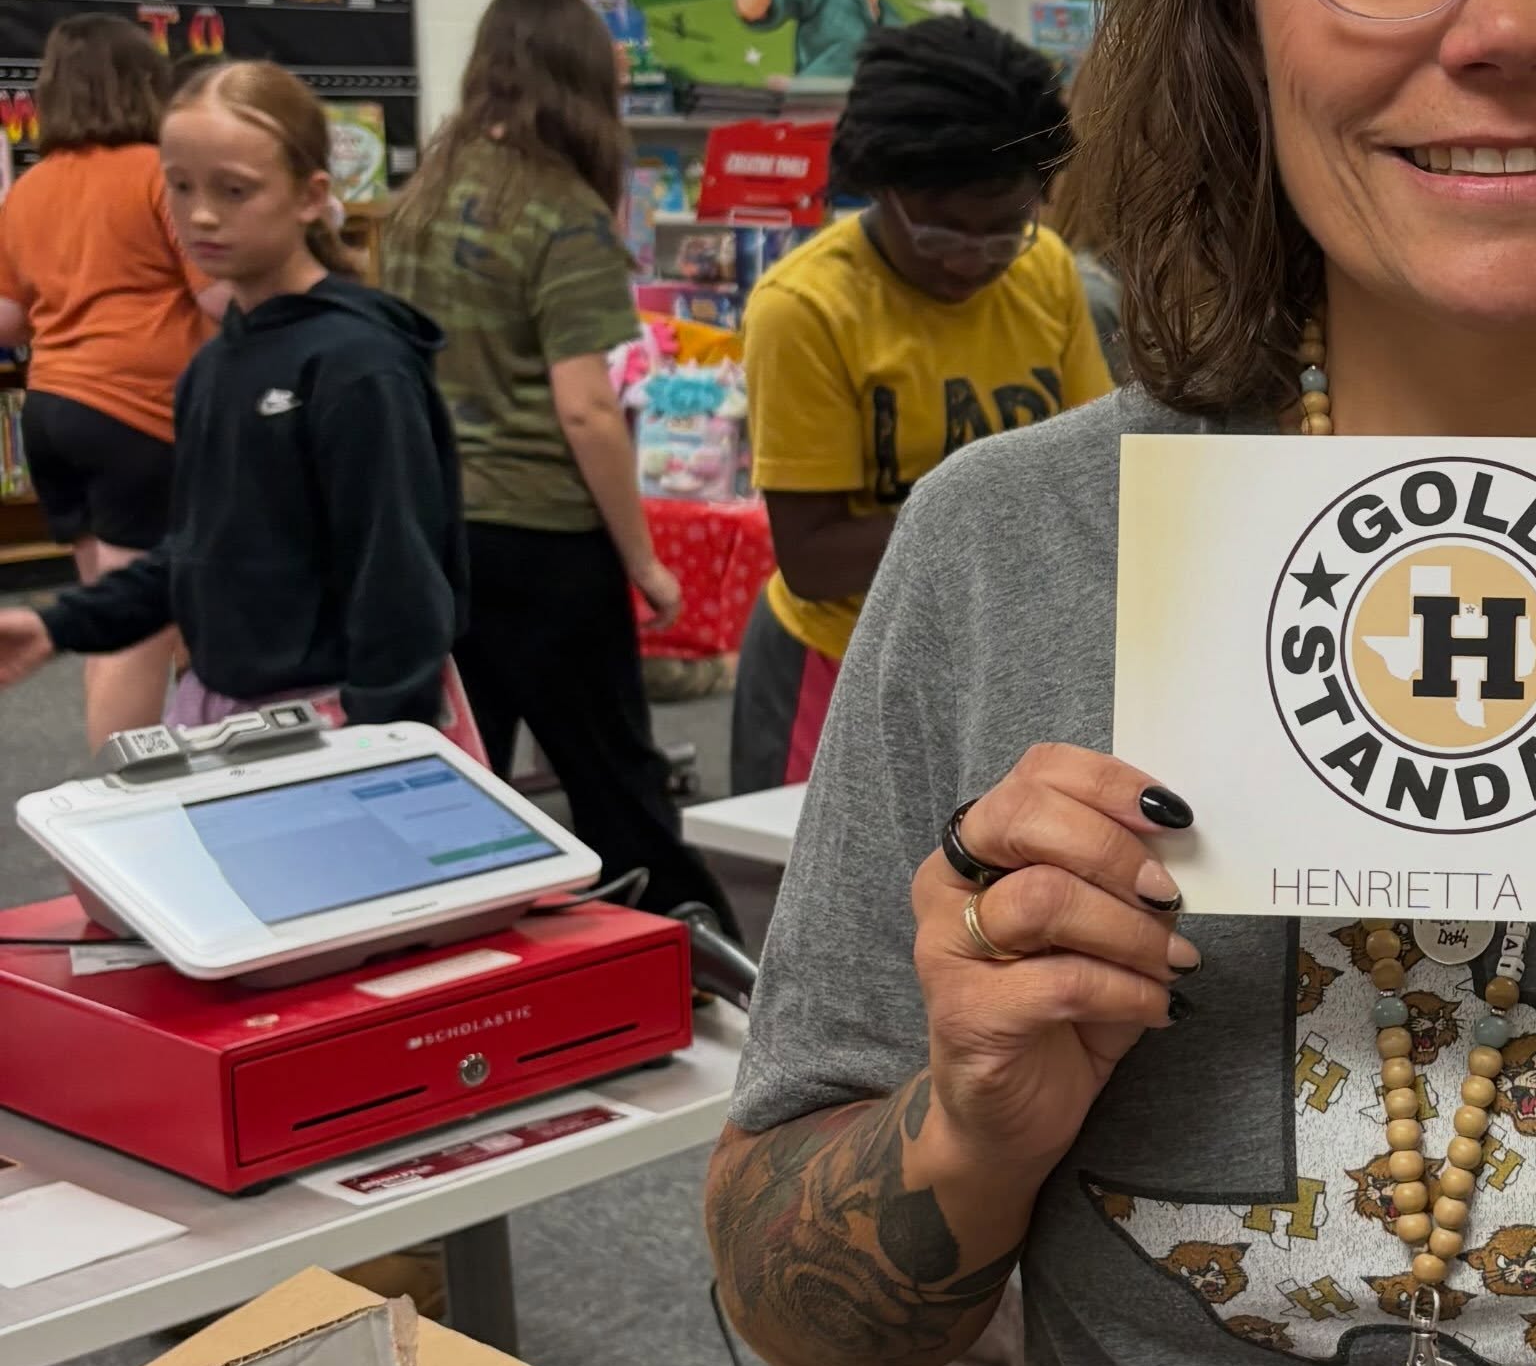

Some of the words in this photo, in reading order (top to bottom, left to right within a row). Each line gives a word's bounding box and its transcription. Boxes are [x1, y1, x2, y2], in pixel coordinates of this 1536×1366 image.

[1412, 595, 1527, 700] H
[1272, 867, 1522, 911] HENRIETTA
[423, 1005, 532, 1046] SCHOLASTIC
